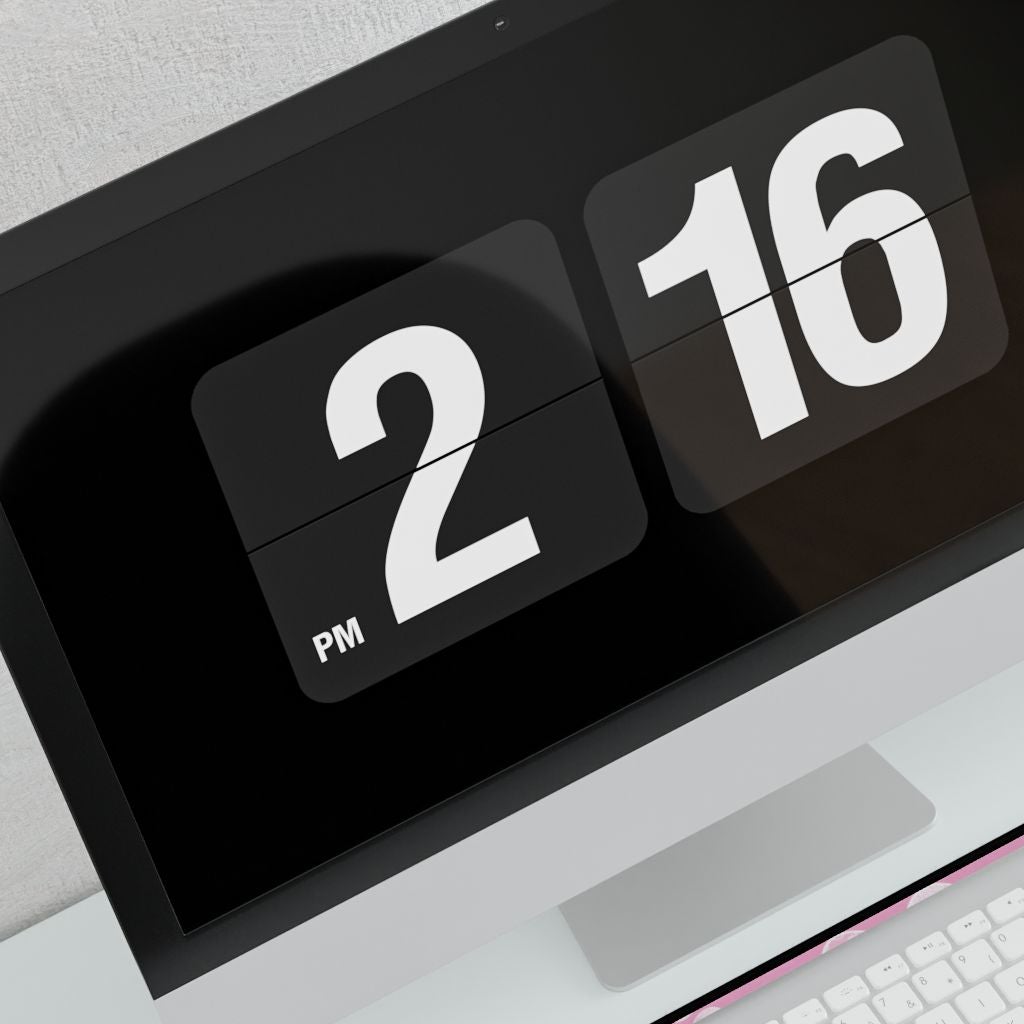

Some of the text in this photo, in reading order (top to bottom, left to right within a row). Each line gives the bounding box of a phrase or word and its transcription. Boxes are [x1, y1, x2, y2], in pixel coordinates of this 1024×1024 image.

[325, 107, 948, 625] 2 16
[311, 616, 365, 664] PM
